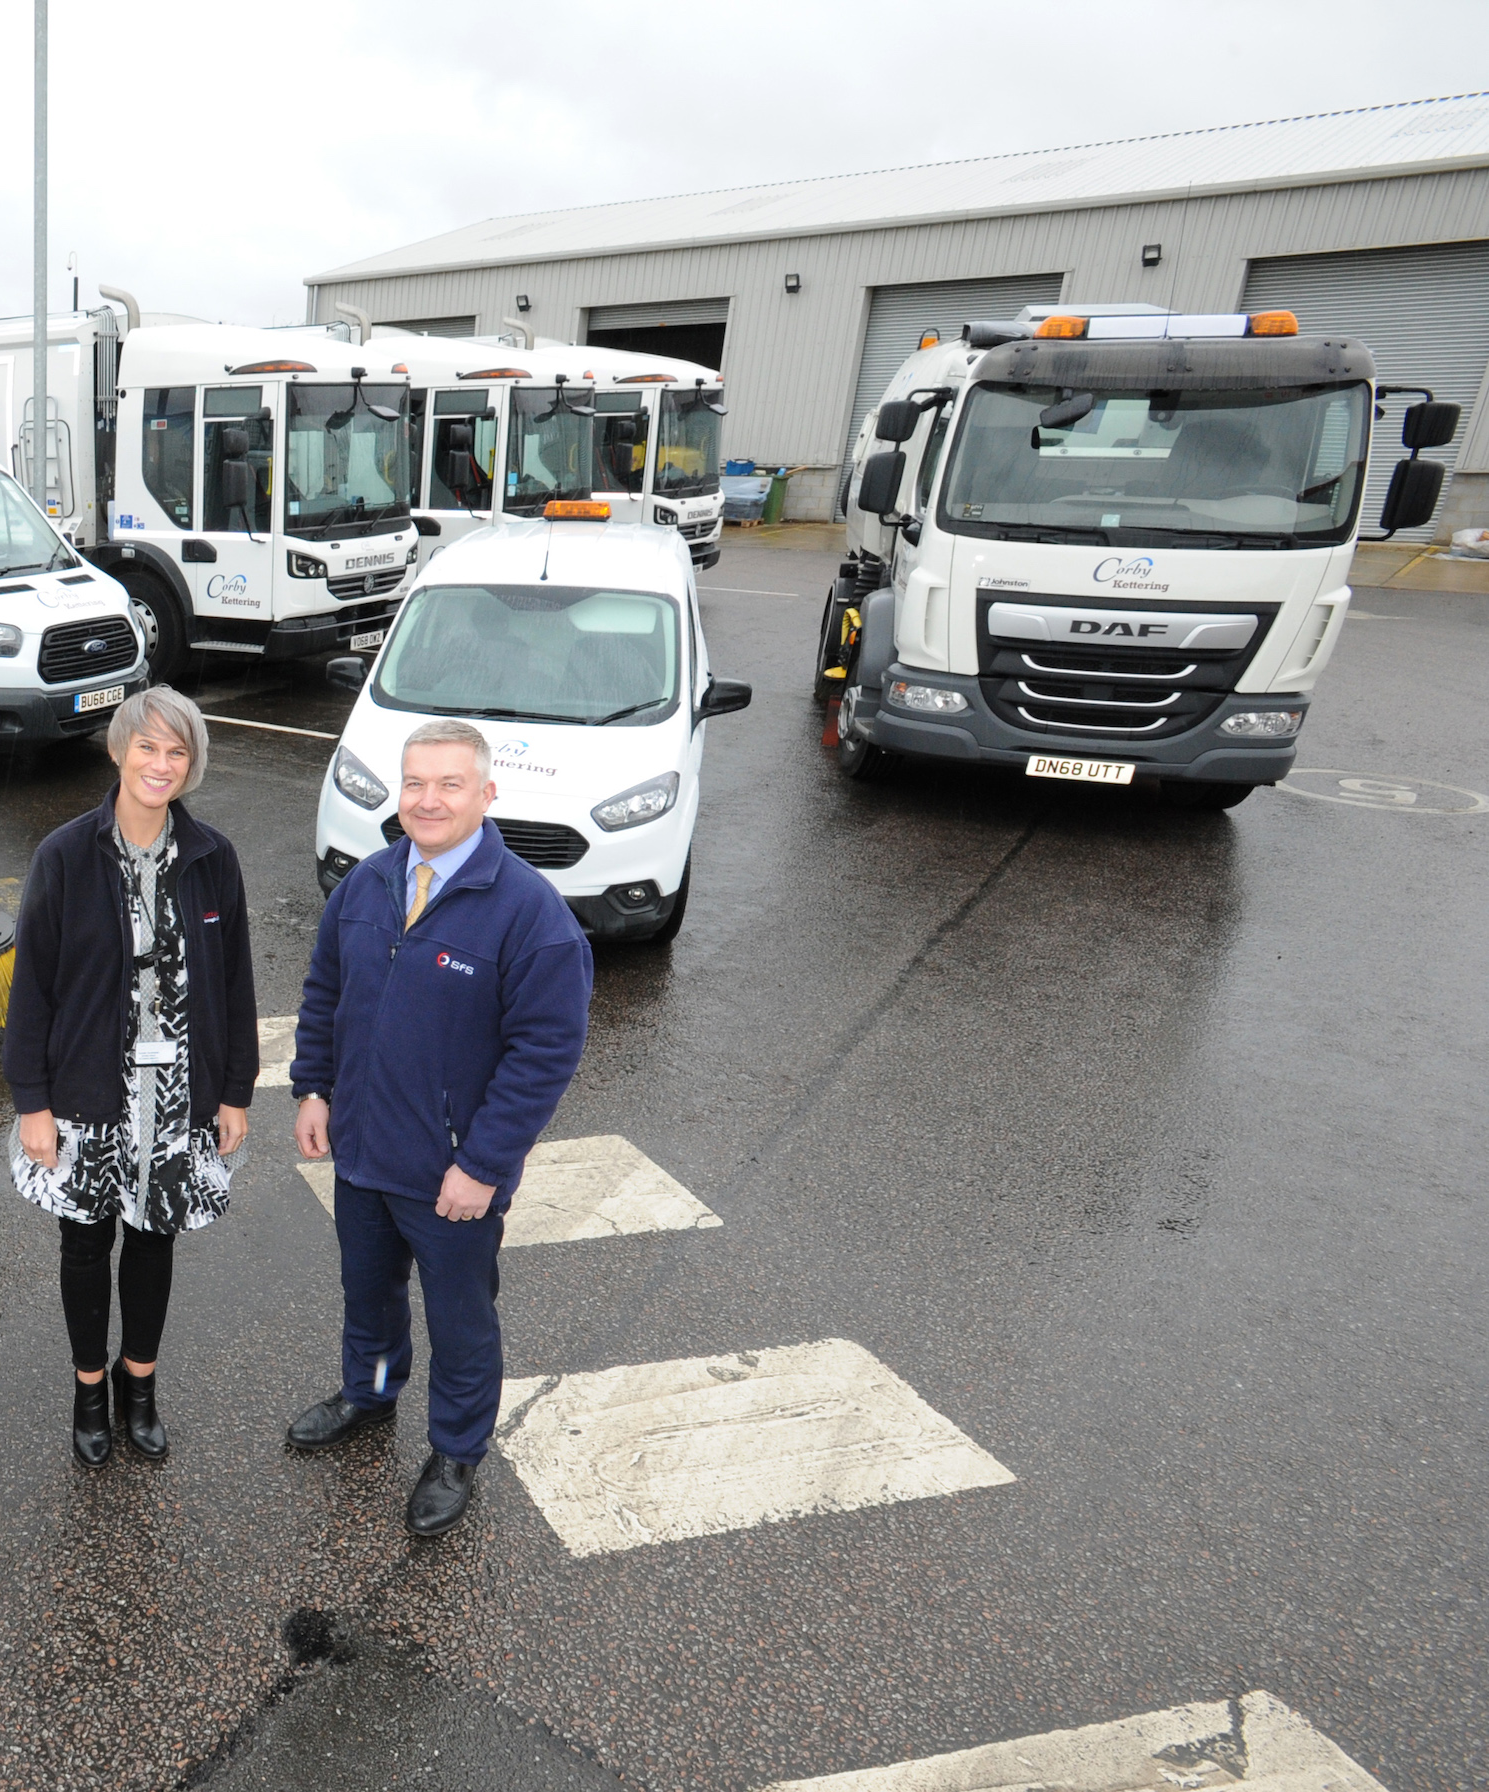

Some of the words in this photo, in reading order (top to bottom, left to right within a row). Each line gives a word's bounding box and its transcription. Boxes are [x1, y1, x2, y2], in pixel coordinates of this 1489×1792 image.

[687, 507, 714, 520] DENNIS
[344, 552, 396, 571] DENNIS
[1092, 557, 1154, 583] Corby
[206, 574, 247, 599] Corby
[989, 578, 1030, 589] Johnston
[1111, 579, 1171, 593] Kettering
[221, 596, 261, 609] Kettering
[1069, 619, 1170, 637] DAF
[81, 692, 105, 708] BU68
[106, 687, 123, 703] CGE
[493, 759, 558, 777] ttering
[1034, 758, 1084, 776] DN68
[1087, 763, 1126, 780] UTT
